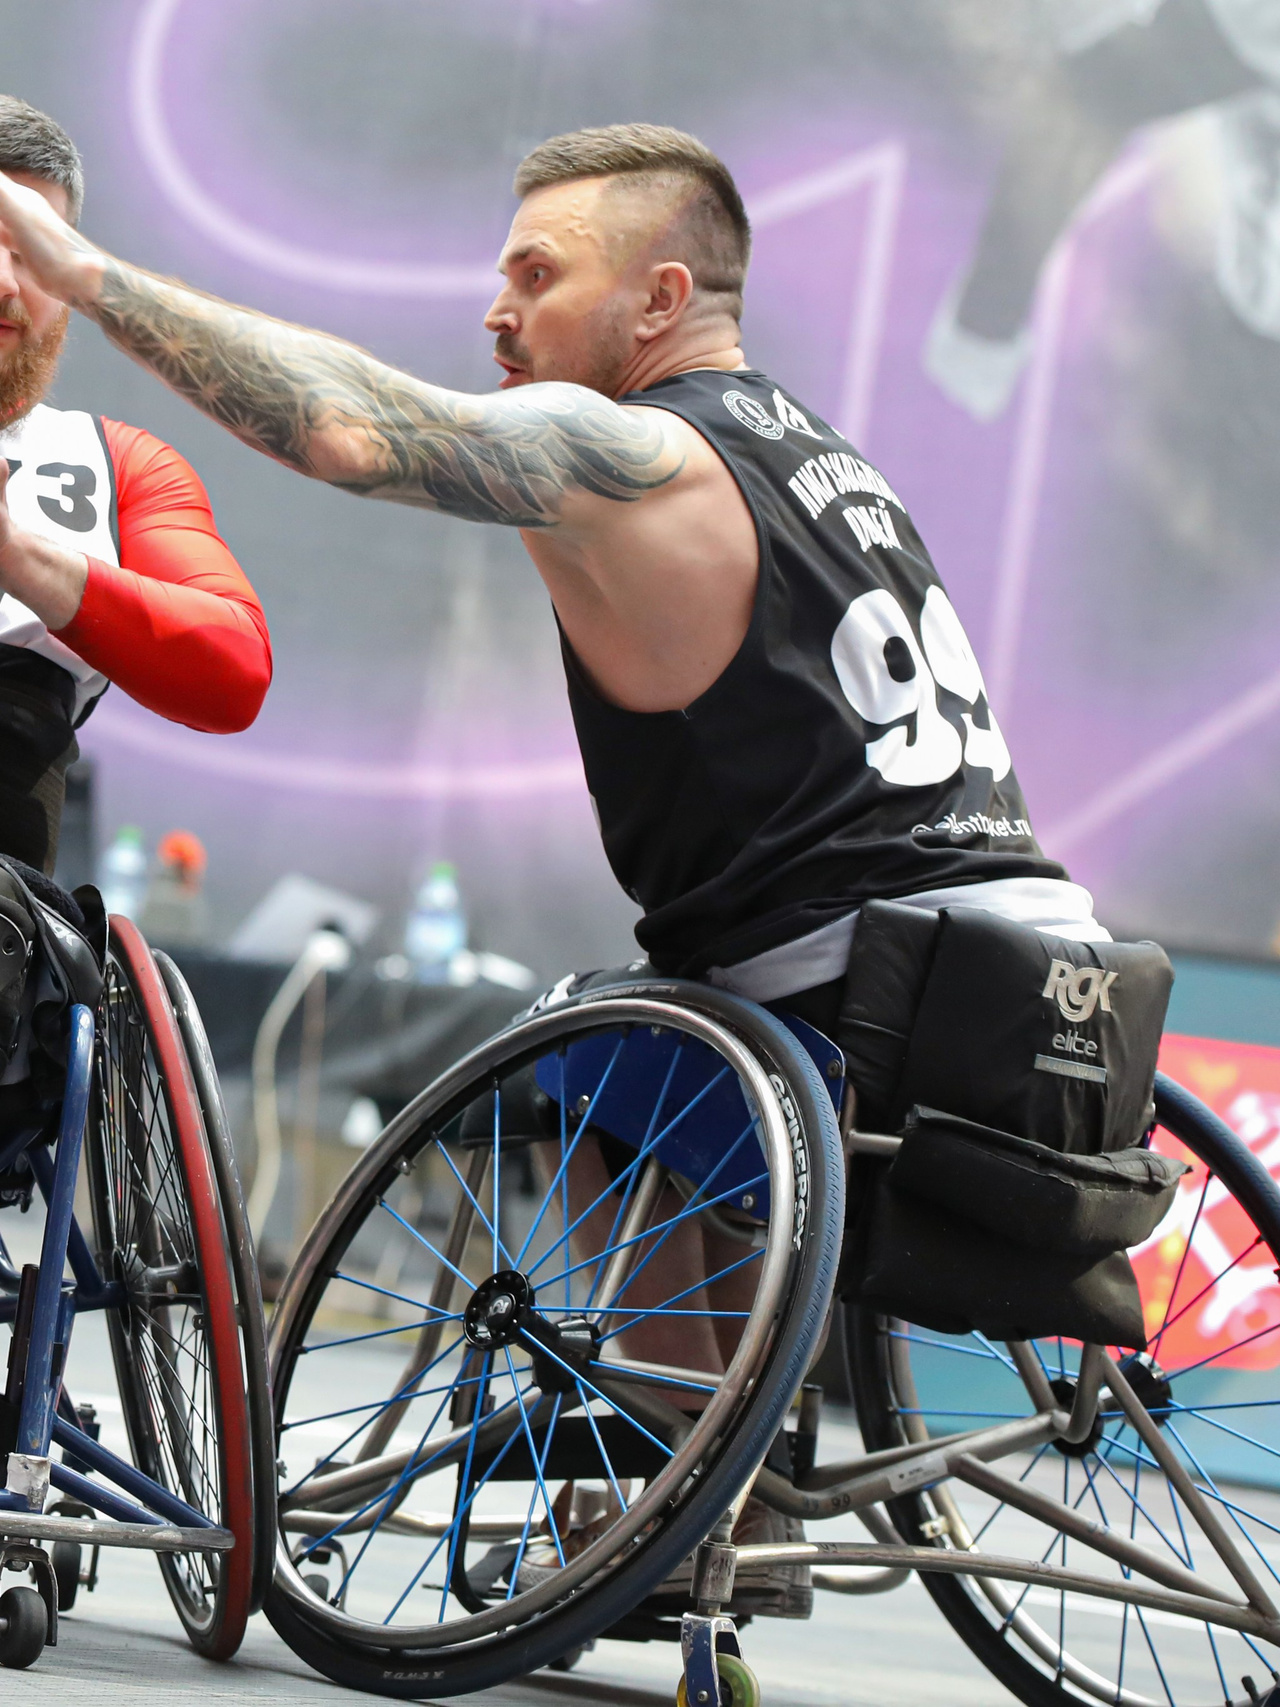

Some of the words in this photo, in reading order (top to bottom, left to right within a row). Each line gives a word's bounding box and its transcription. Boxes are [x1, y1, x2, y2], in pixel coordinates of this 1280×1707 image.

[8, 458, 98, 533] 3
[830, 583, 1012, 787] 99
[1051, 1028, 1098, 1058] elite
